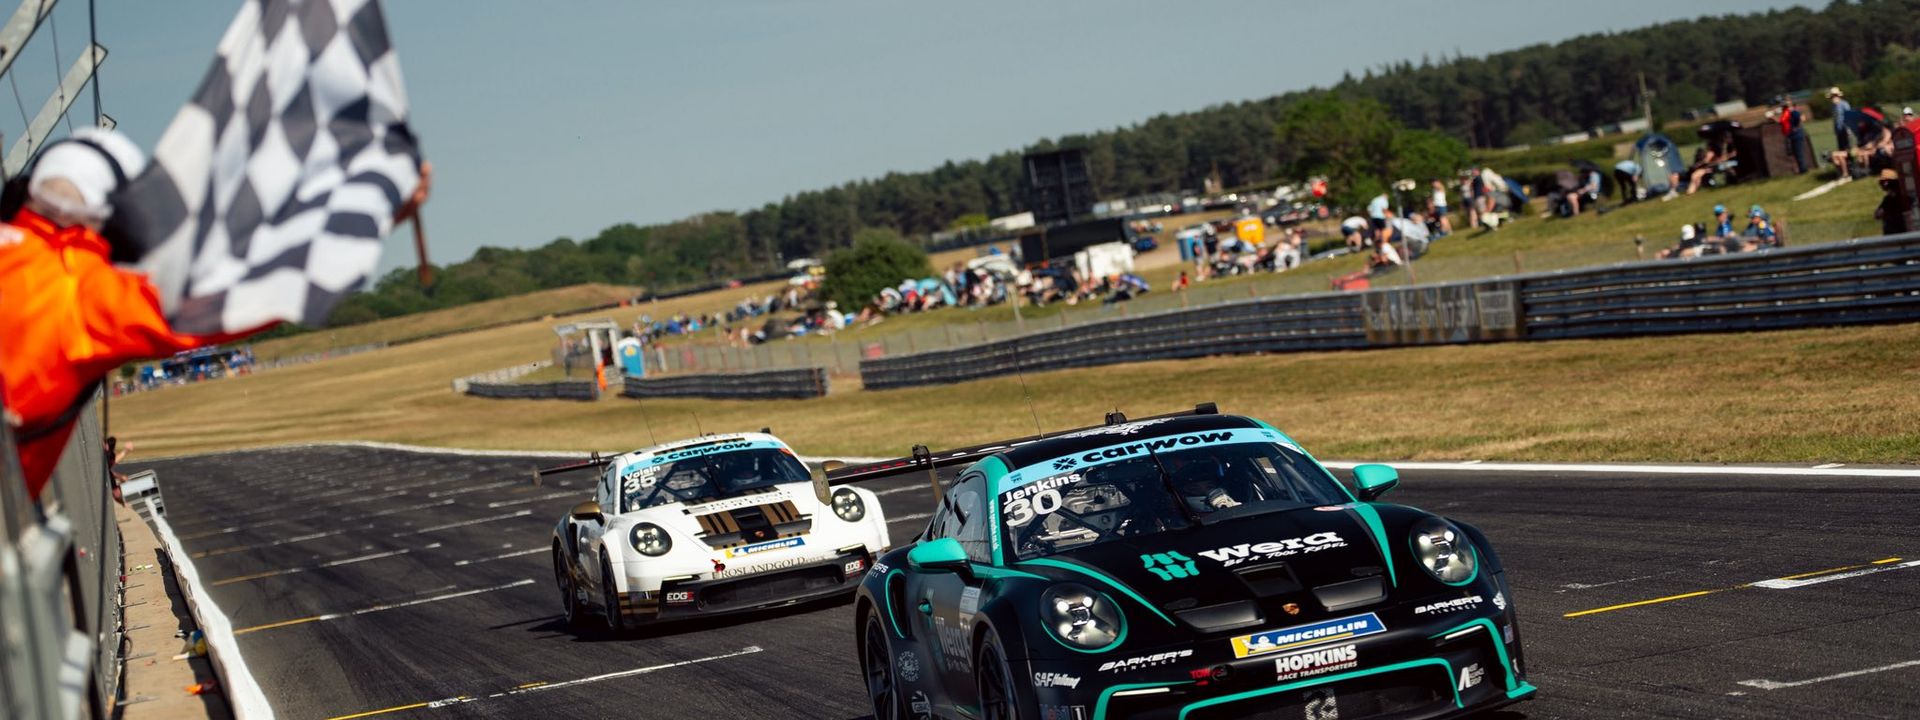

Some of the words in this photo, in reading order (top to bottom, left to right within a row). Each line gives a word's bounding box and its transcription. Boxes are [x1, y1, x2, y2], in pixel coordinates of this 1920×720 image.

[667, 442, 753, 460] carwow
[1083, 431, 1234, 463] carwow
[624, 465, 661, 481] Voisin
[624, 474, 657, 494] 35
[1003, 472, 1082, 506] Jenkins
[1003, 488, 1063, 528] 30
[747, 539, 799, 554] MICHELIN
[1198, 531, 1344, 562] Wera
[1266, 549, 1298, 559] TOOL
[1303, 541, 1349, 554] REBEL
[1277, 620, 1368, 645] MICHELIN
[1098, 649, 1193, 672] BARKER'S
[1114, 658, 1177, 674] FINANCE
[1275, 644, 1358, 673] HOPKINS
[1277, 673, 1298, 681] RACE
[1300, 661, 1358, 678] TRANSPORTERS
